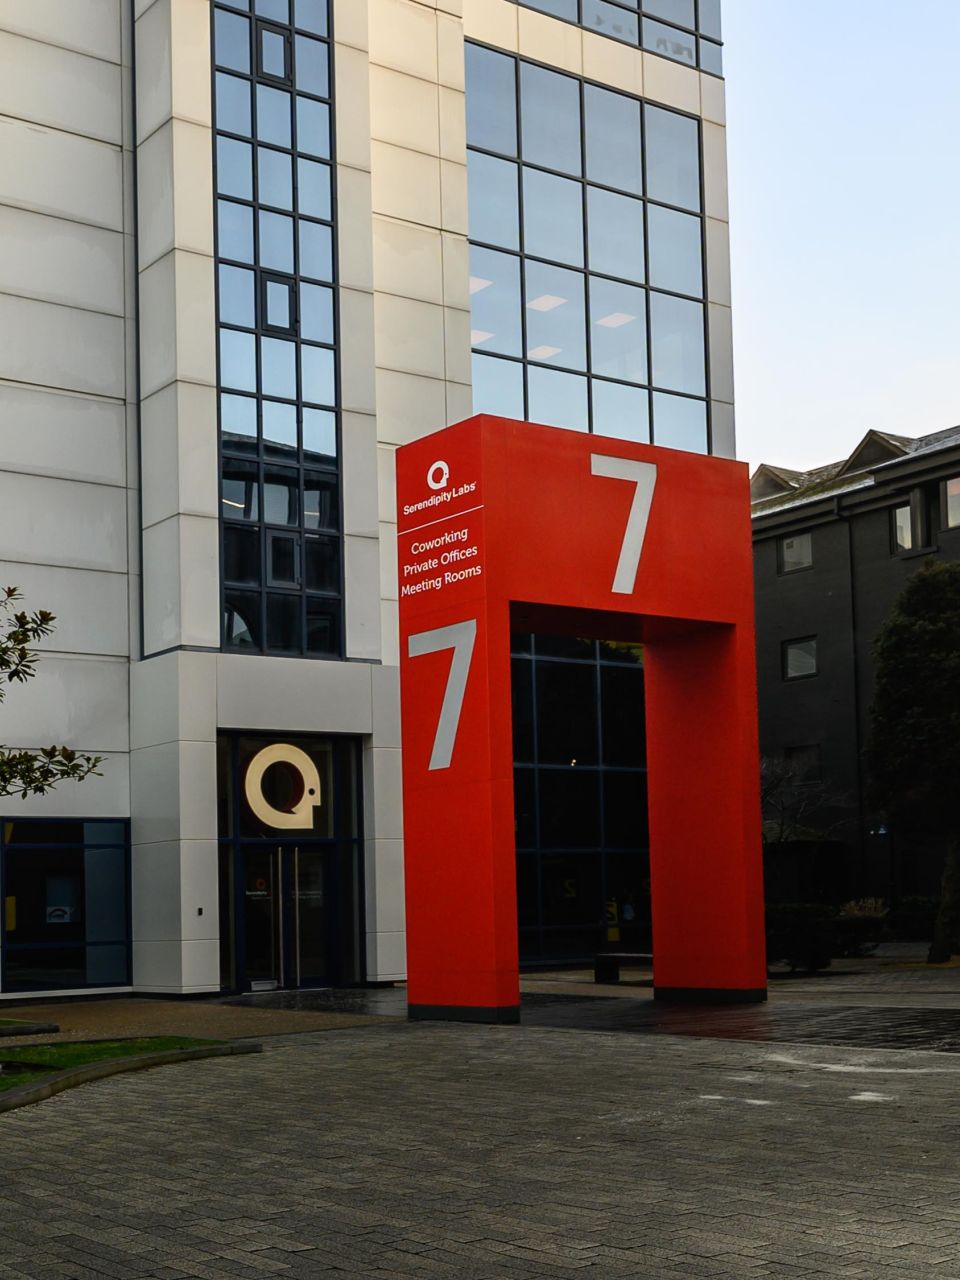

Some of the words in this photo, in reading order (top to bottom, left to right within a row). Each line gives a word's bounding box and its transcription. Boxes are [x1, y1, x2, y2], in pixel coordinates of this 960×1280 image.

[403, 491, 452, 516] Serendipity
[590, 452, 658, 595] 7
[411, 528, 468, 555] Coworking
[403, 558, 439, 577] Private
[440, 545, 478, 565] Offices
[401, 577, 442, 597] Meeting
[444, 565, 482, 584] Rooms
[407, 618, 477, 772] 7
